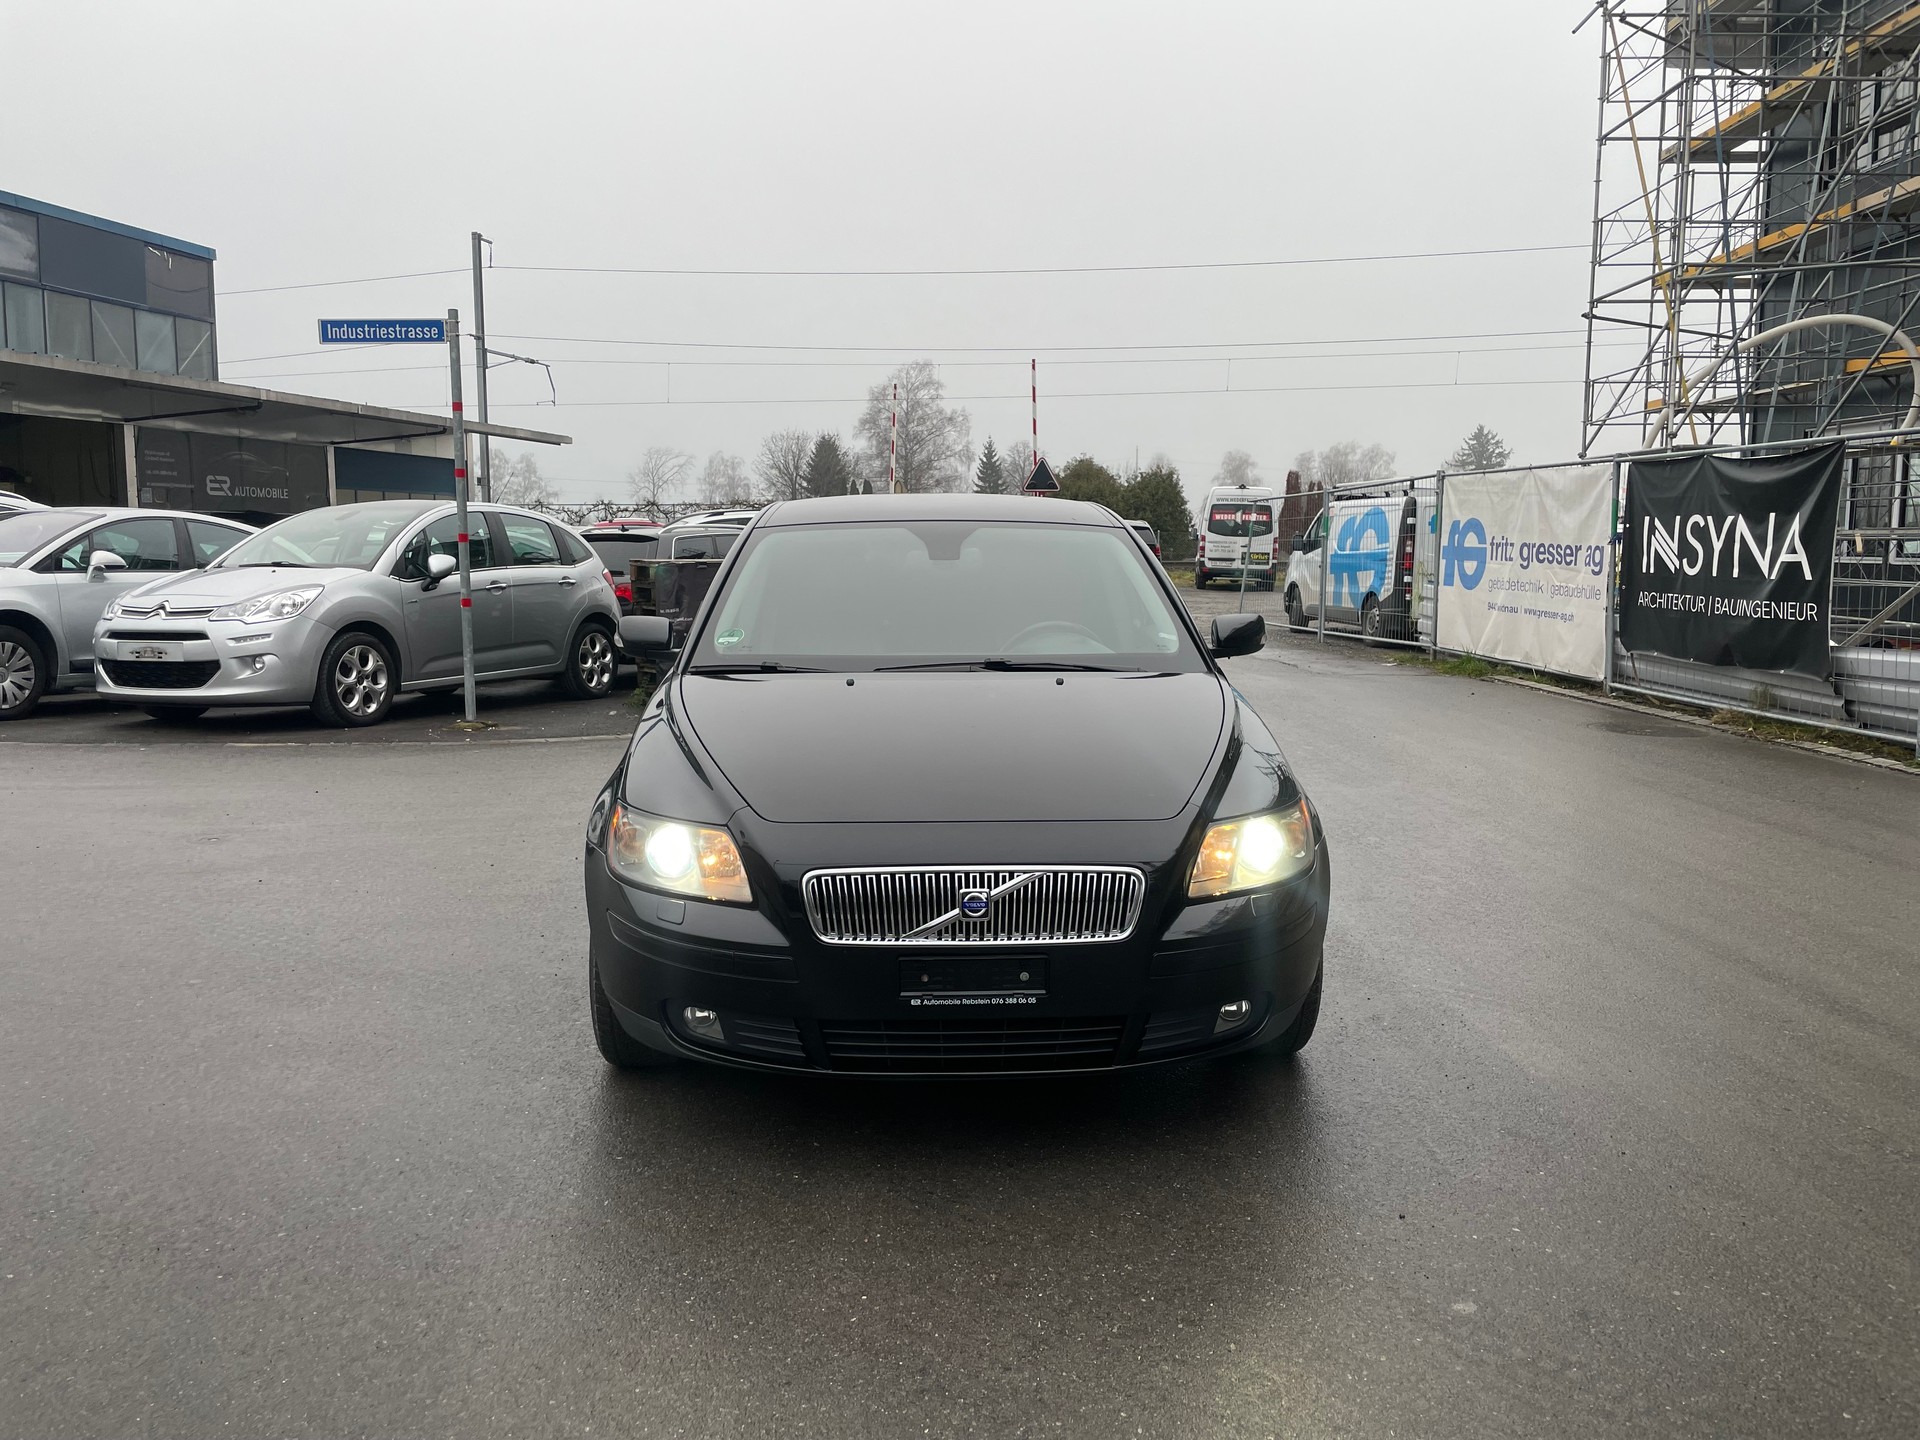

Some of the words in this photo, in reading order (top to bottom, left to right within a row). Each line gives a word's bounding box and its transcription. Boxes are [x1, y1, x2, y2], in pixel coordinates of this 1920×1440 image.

[327, 323, 438, 339] Industriestrasse
[234, 486, 289, 499] AUTOMOBILE
[1642, 512, 1812, 581] INSYNA
[1489, 535, 1515, 562] fritz
[1519, 541, 1582, 570] gresser
[1584, 544, 1605, 576] ag
[1638, 591, 1705, 613] ARCHITEKTUR
[1714, 597, 1818, 622] BAUINGENIEUR
[1523, 607, 1575, 623] www.gresser-ag.ch
[922, 998, 961, 1006] Automobile
[991, 997, 1004, 1005] 076
[1027, 996, 1037, 1004] 05
